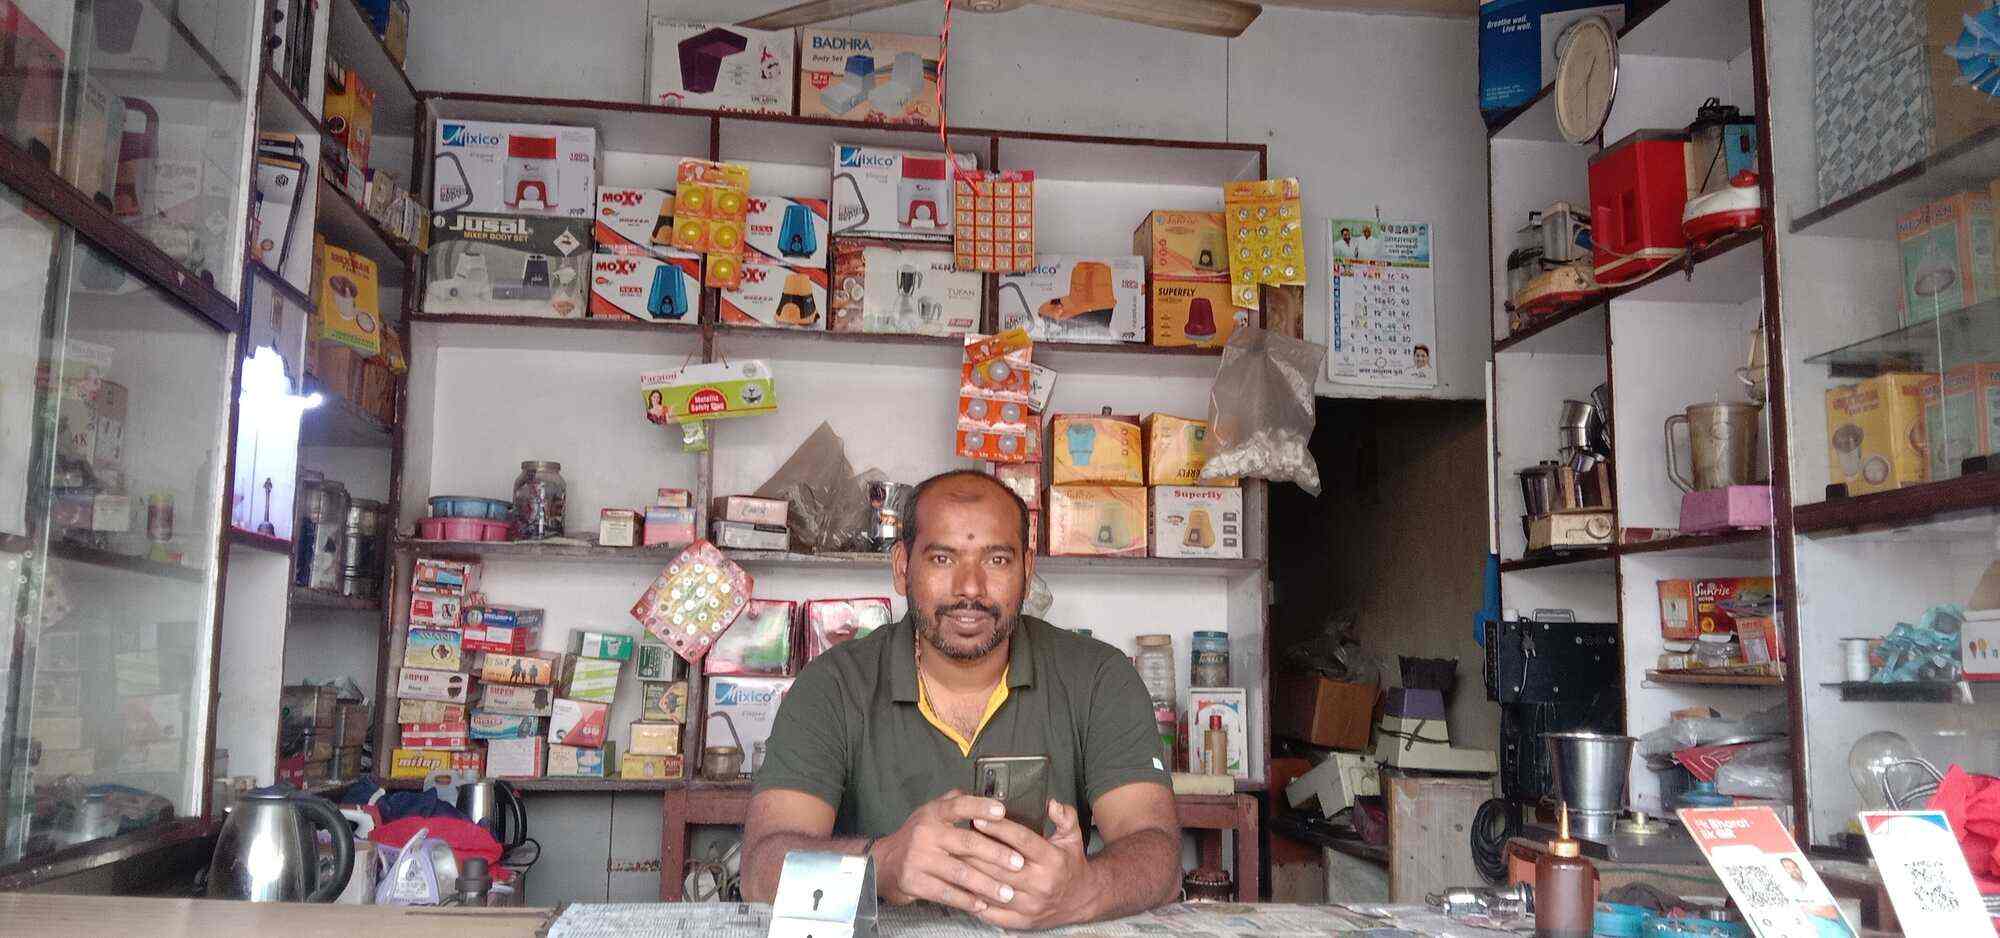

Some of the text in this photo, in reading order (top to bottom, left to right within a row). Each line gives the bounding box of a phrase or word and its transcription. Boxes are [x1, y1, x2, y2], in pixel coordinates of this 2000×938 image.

[1502, 24, 1515, 34] Live
[813, 36, 873, 51] BADHRA
[464, 231, 529, 243] MIXER BODY SET
[1158, 287, 1196, 297] SUPERFLY
[1174, 489, 1223, 501] Superfly
[715, 682, 771, 705] Mixico
